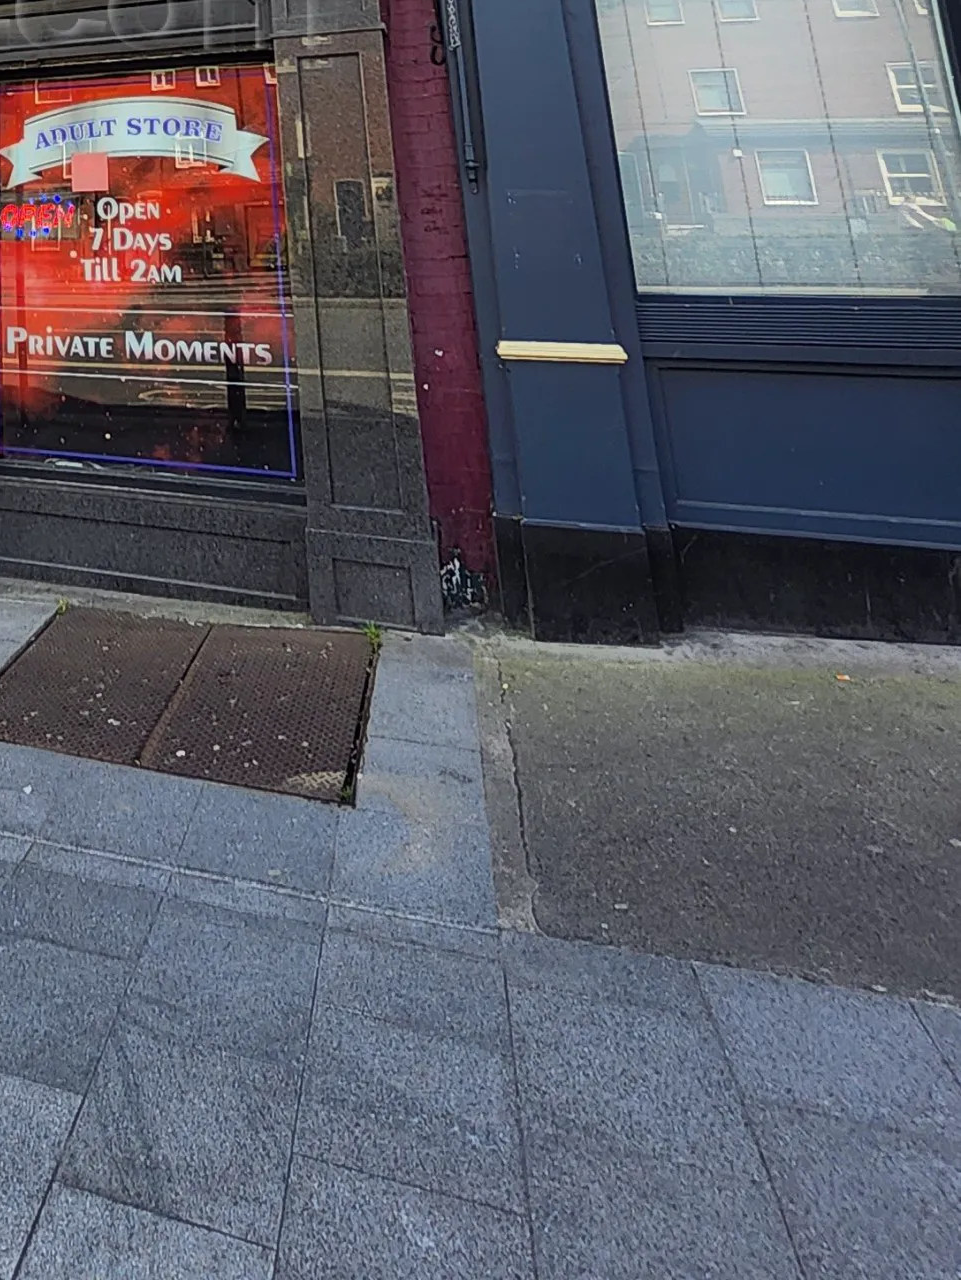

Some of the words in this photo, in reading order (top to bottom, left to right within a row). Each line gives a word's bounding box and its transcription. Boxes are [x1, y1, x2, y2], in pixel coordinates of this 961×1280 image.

[35, 119, 117, 150] ADULT
[127, 117, 223, 142] STORE
[0, 204, 75, 228] OPEN
[90, 228, 103, 251] 7
